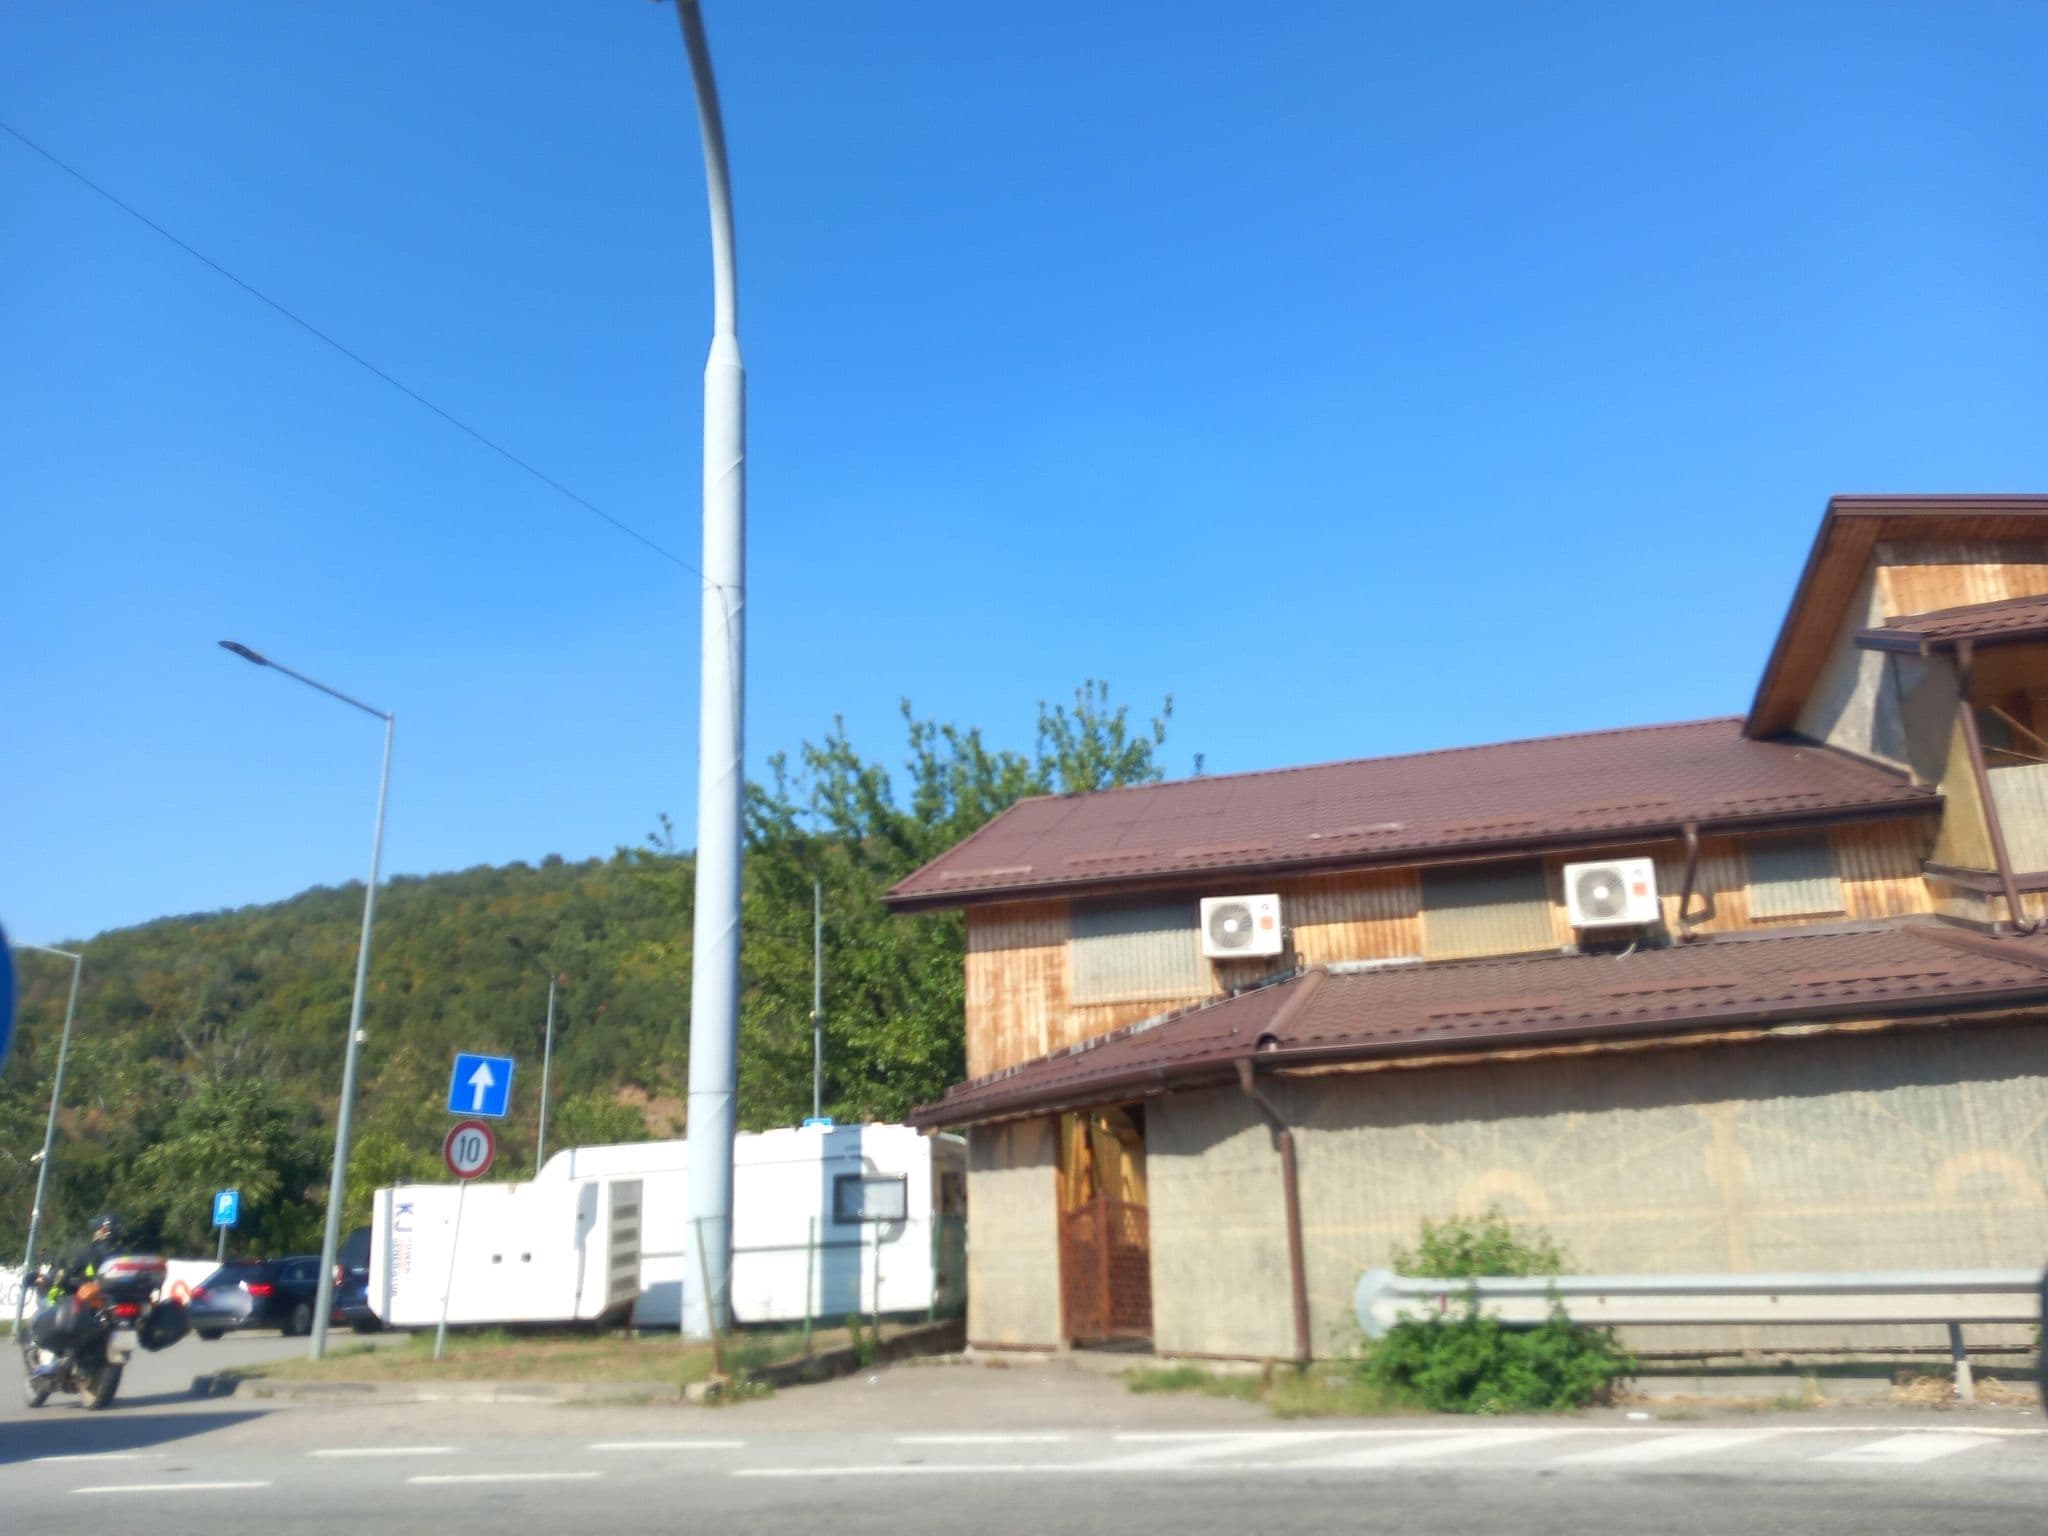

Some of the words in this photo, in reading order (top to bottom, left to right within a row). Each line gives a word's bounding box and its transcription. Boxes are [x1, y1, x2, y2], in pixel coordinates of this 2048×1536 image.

[459, 1136, 481, 1163] 10
[218, 1195, 233, 1214] P
[395, 1202, 414, 1233] KJ
